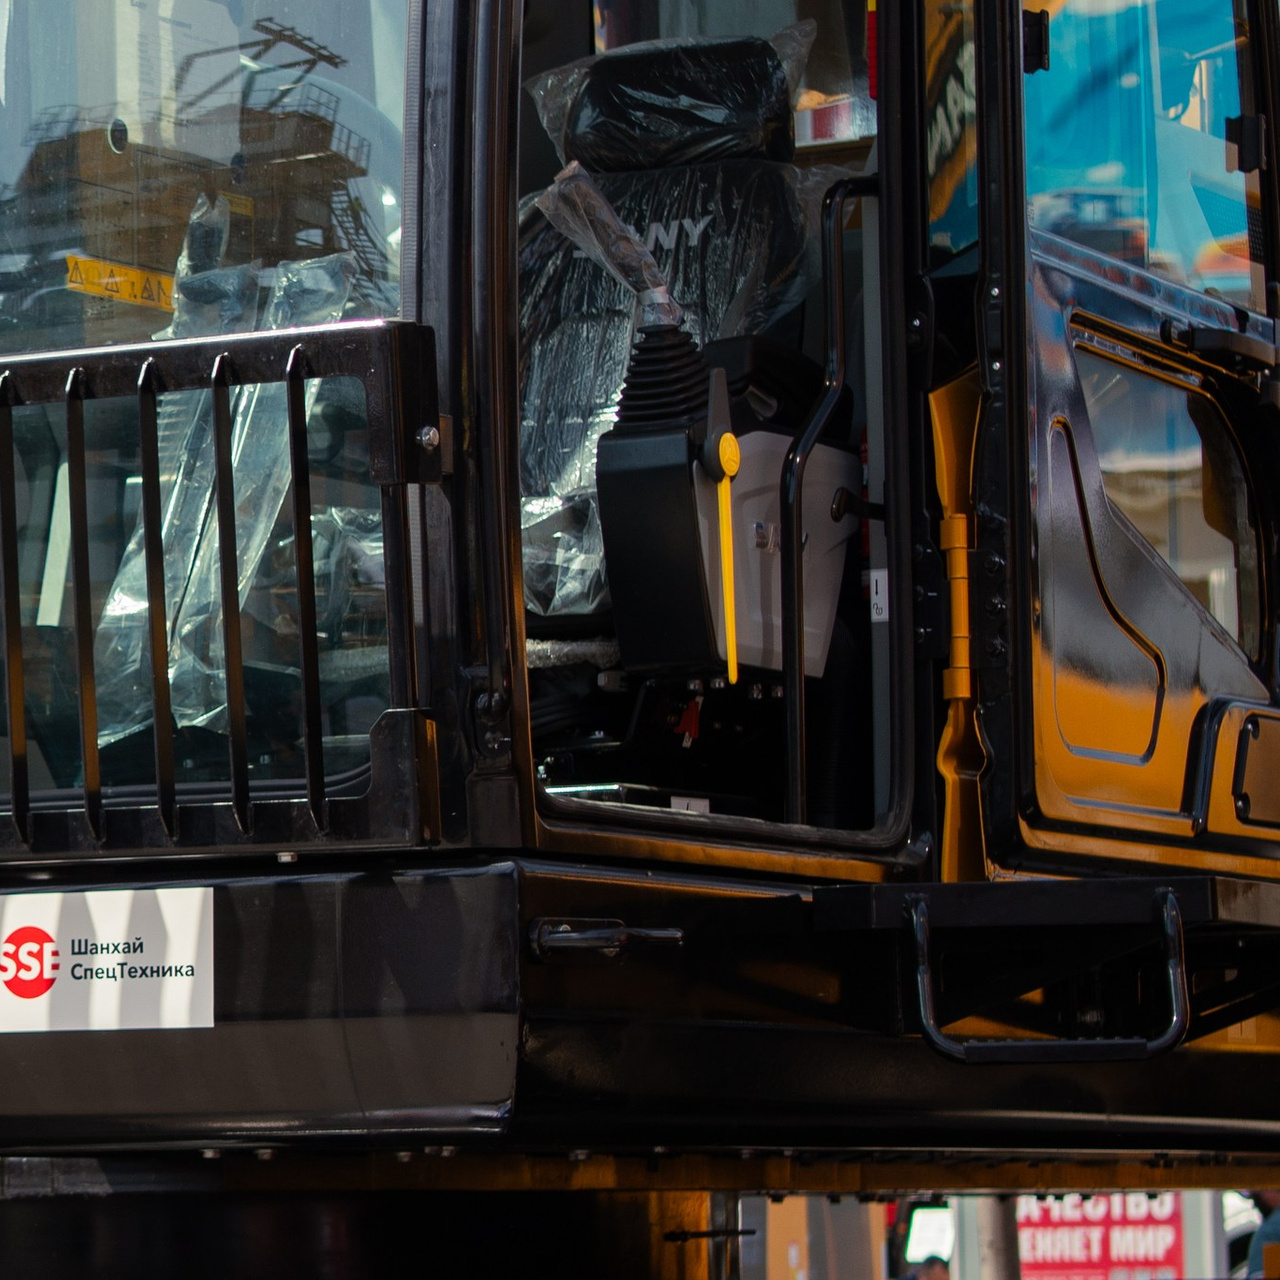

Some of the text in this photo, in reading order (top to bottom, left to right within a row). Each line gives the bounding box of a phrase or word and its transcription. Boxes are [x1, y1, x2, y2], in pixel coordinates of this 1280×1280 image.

[71, 936, 144, 956] Шанхай
[71, 962, 195, 982] СпецТехника
[1109, 1225, 1175, 1262] МИР
